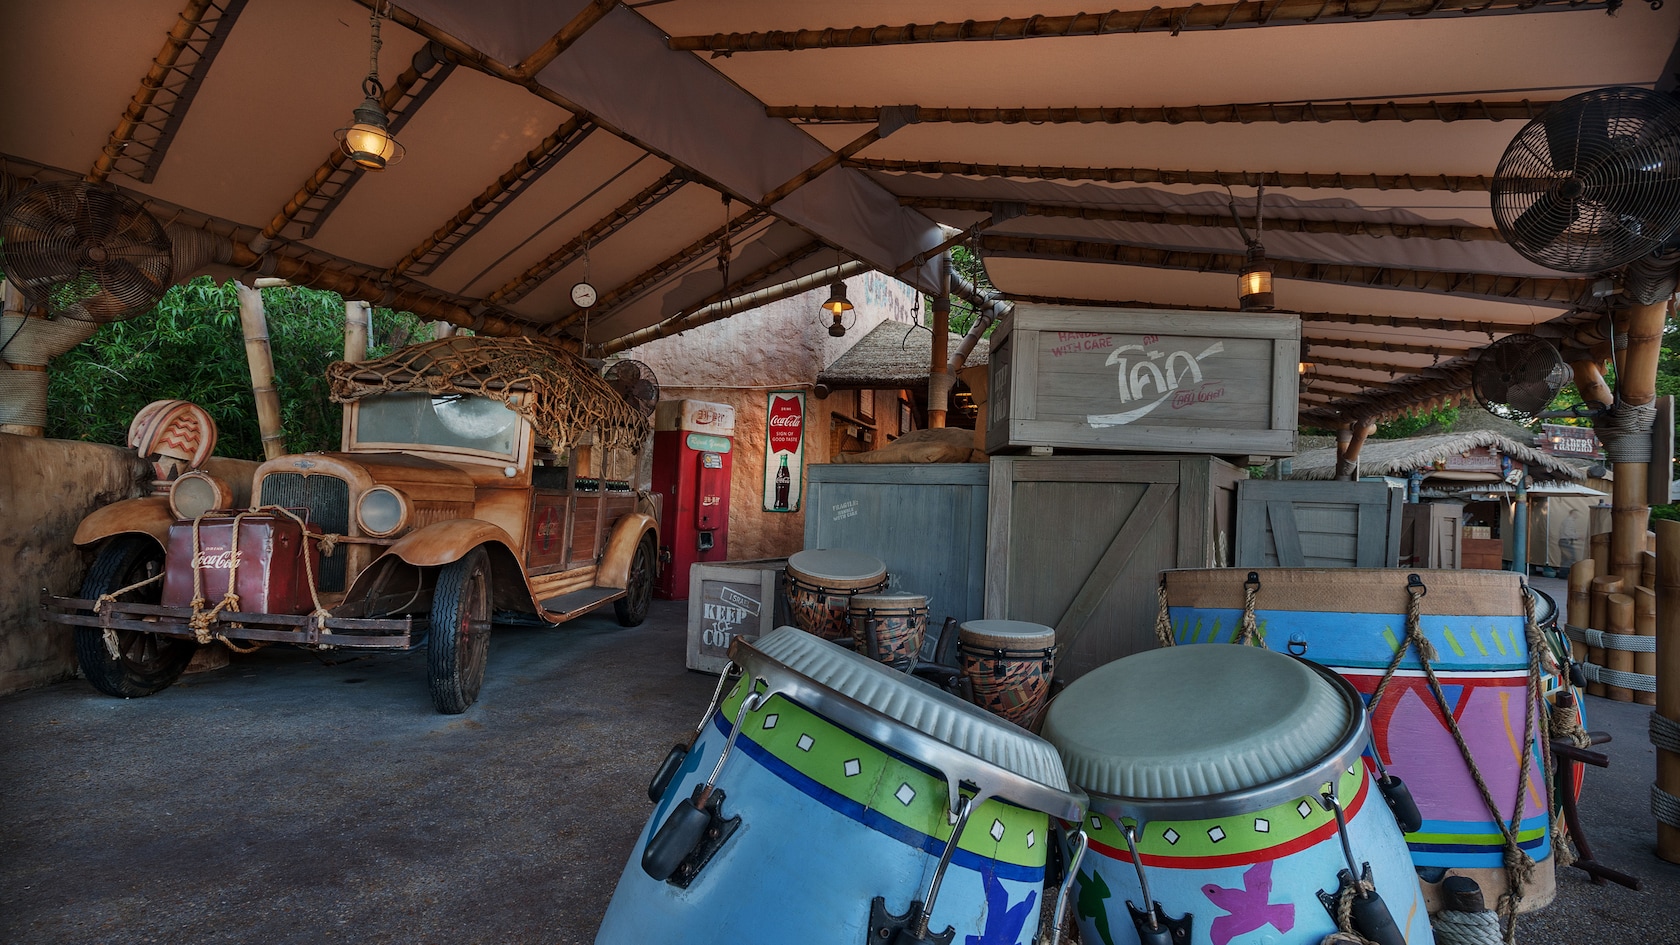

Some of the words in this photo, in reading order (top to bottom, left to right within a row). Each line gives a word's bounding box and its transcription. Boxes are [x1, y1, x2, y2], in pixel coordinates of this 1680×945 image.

[1058, 332, 1104, 342] HAND
[1052, 342, 1082, 358] WITH
[1084, 337, 1113, 350] CARE
[770, 415, 801, 427] Coca-Cola
[729, 593, 749, 608] ISRAEL
[704, 603, 747, 624] KEEP
[712, 620, 732, 633] ICE
[703, 629, 735, 649] COL
